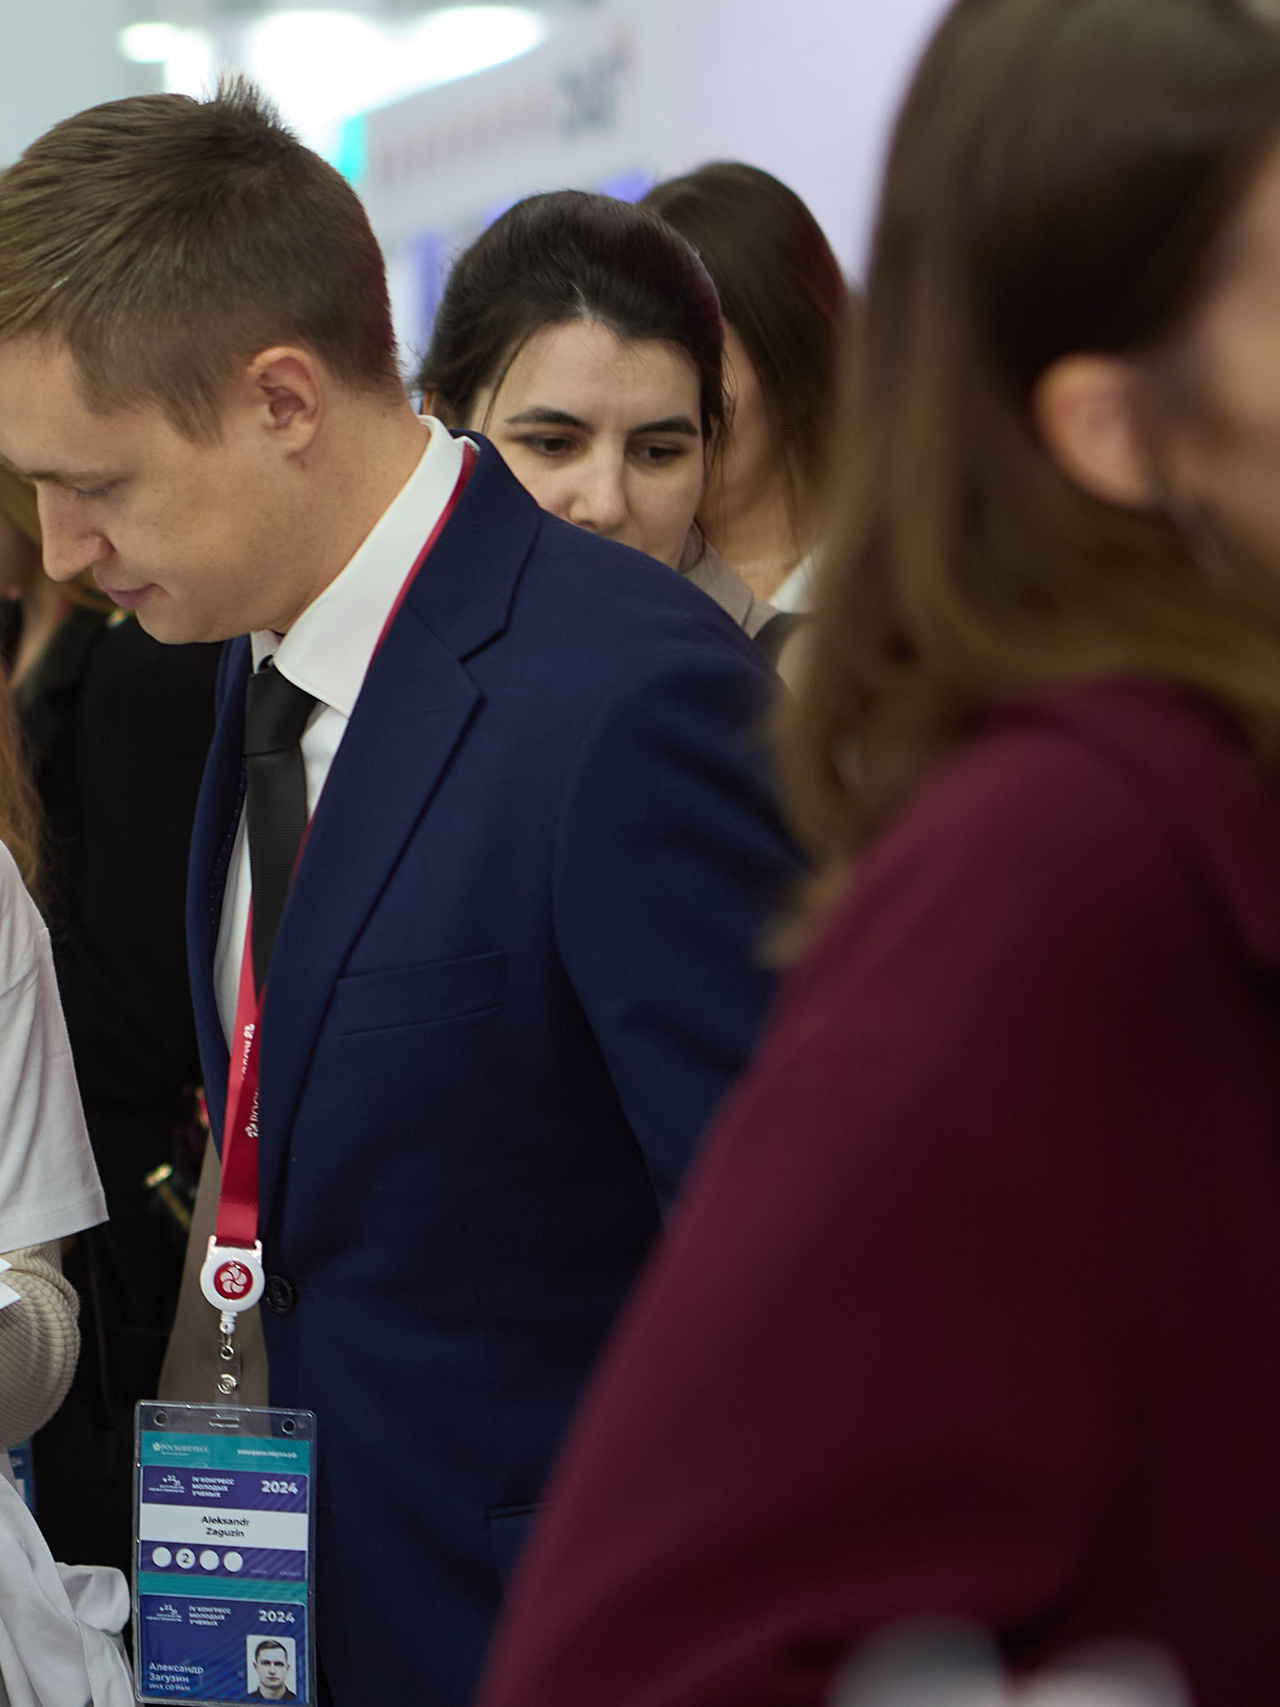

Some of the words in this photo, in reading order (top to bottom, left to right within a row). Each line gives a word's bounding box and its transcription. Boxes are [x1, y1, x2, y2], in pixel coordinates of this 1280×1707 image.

[261, 1480, 299, 1495] 2024
[201, 1515, 250, 1527] Aleksandr
[206, 1527, 245, 1538] Zaguzin
[182, 1553, 191, 1564] 2
[257, 1609, 296, 1624] 2024
[149, 1662, 204, 1675] Александр
[149, 1672, 189, 1684] Загузин
